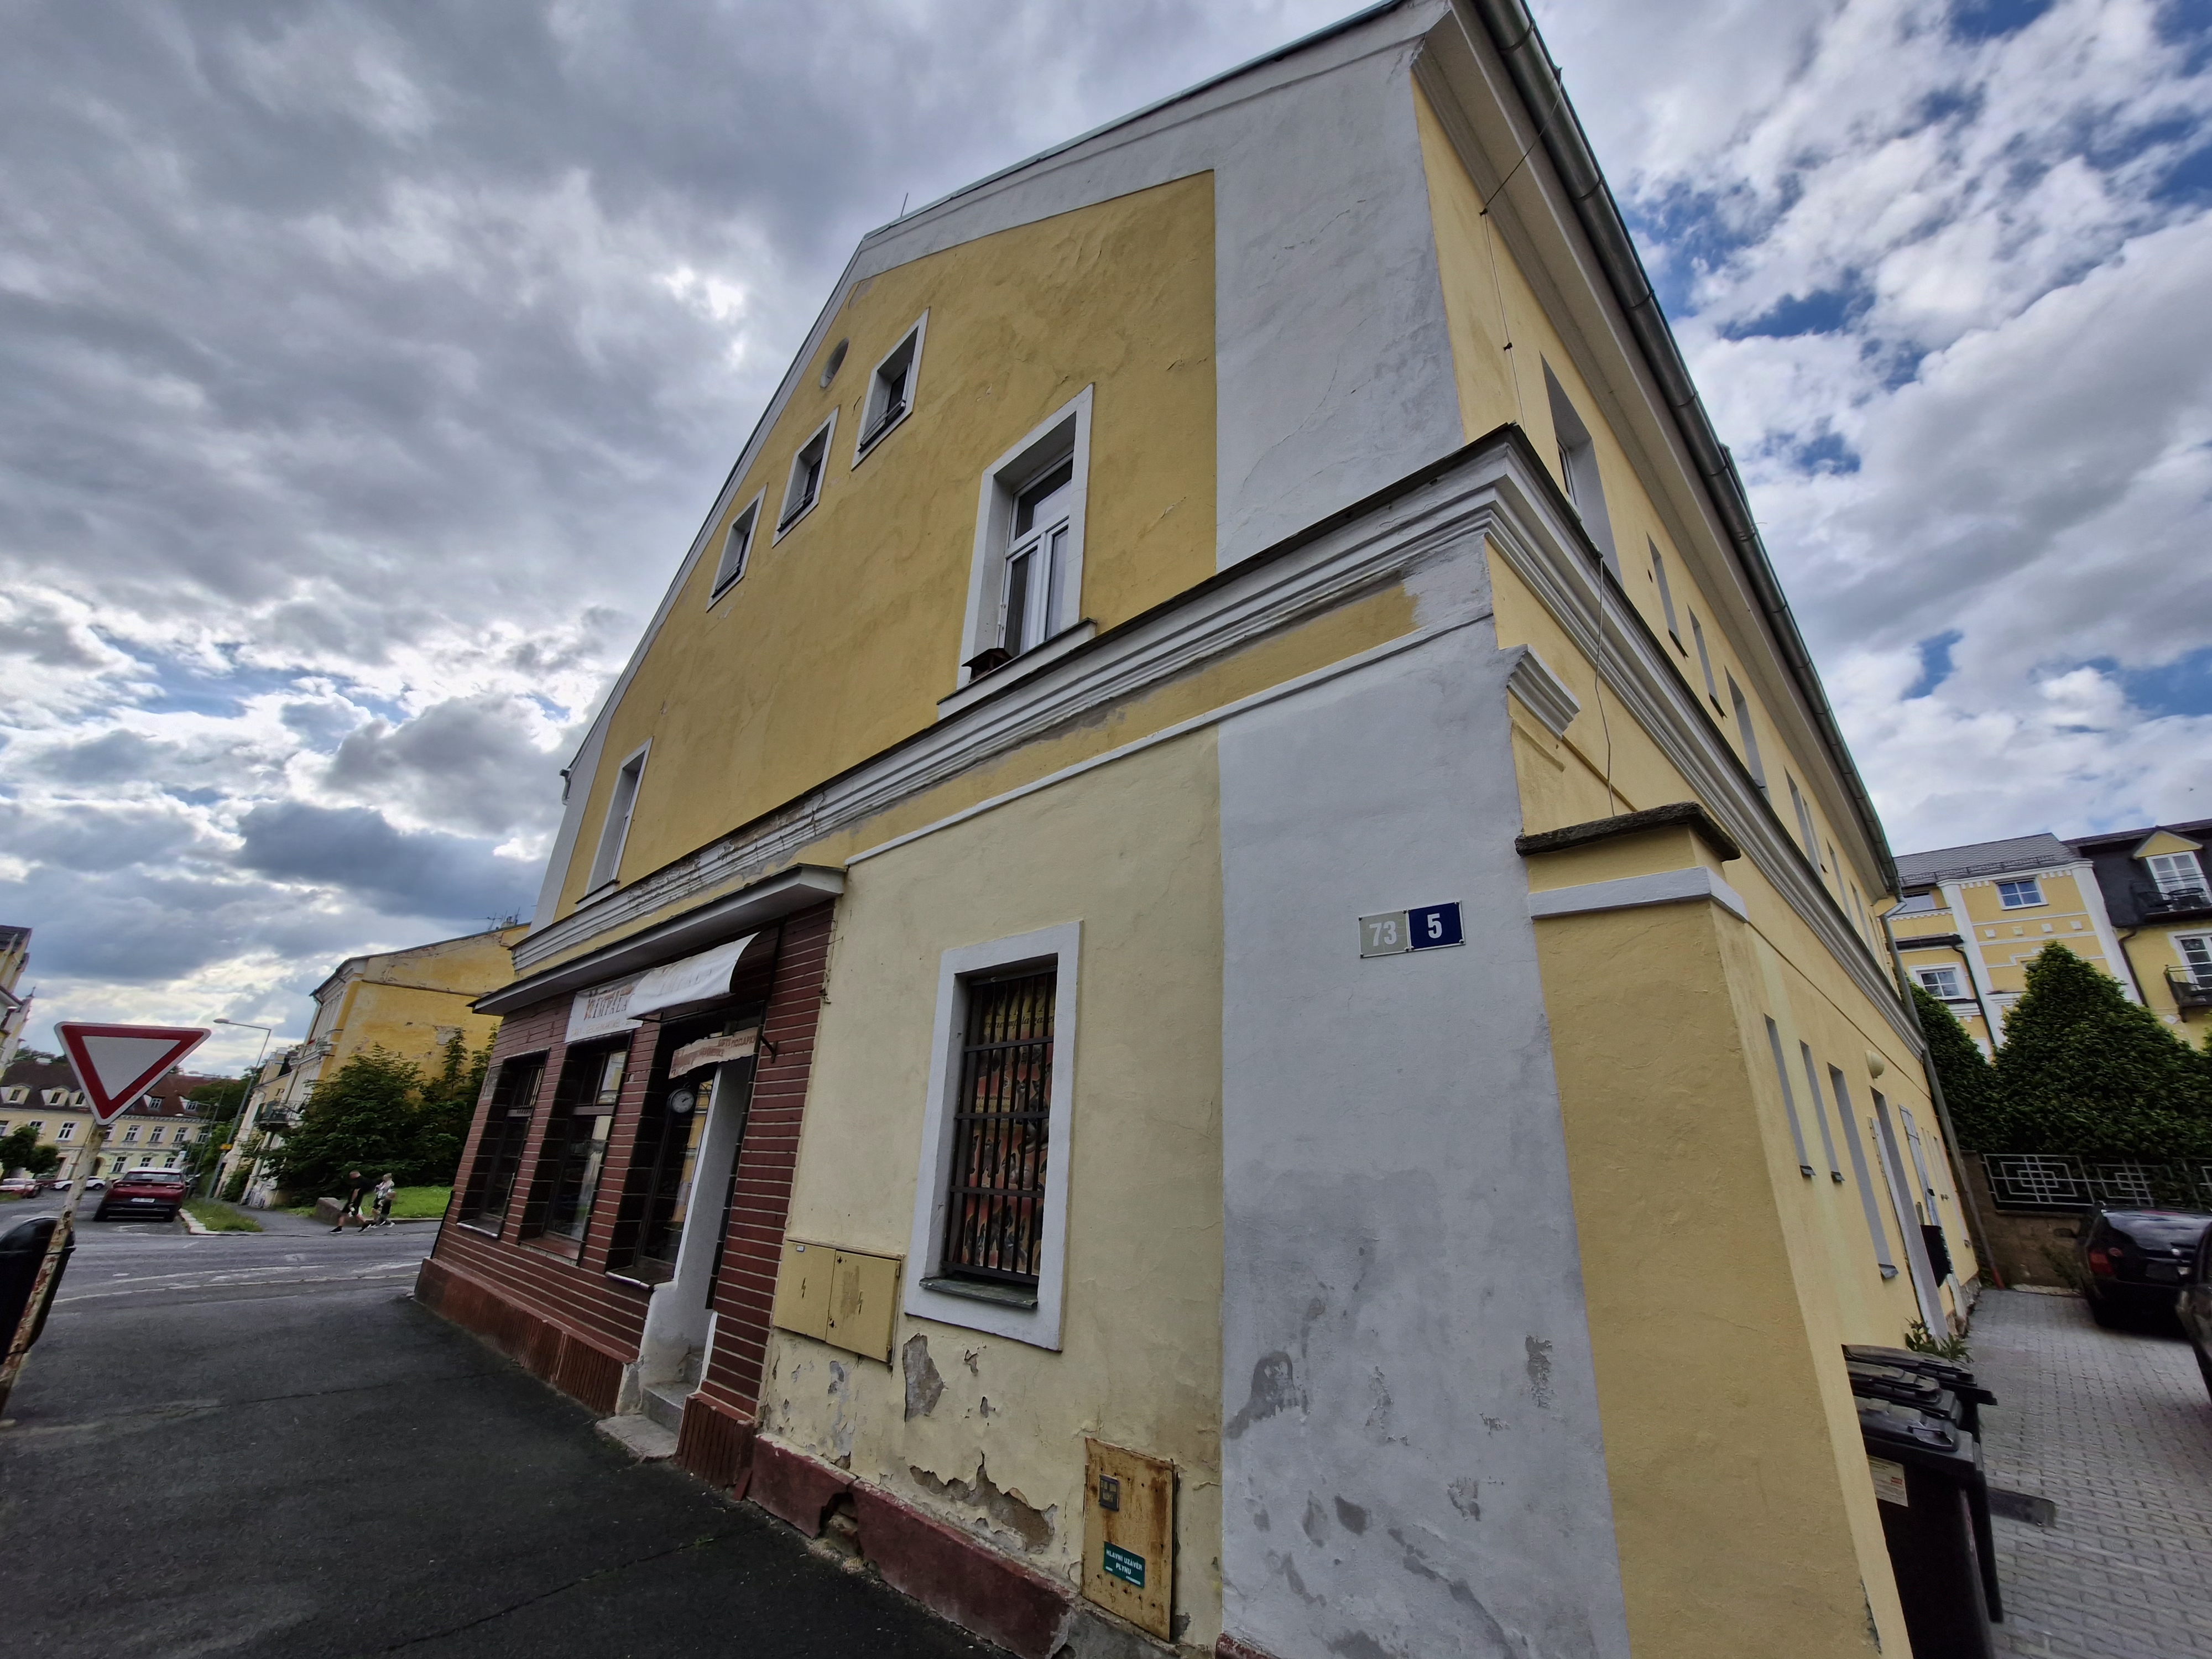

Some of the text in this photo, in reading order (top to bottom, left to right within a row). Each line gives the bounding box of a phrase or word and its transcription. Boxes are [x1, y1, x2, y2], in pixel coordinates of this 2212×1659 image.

[1369, 921, 1397, 947] 73
[1427, 913, 1443, 939] 5
[1106, 1549, 1123, 1562] HLAVNÍ
[1124, 1557, 1142, 1571] UZÁVĚR
[1115, 1562, 1131, 1575] PLYNU
